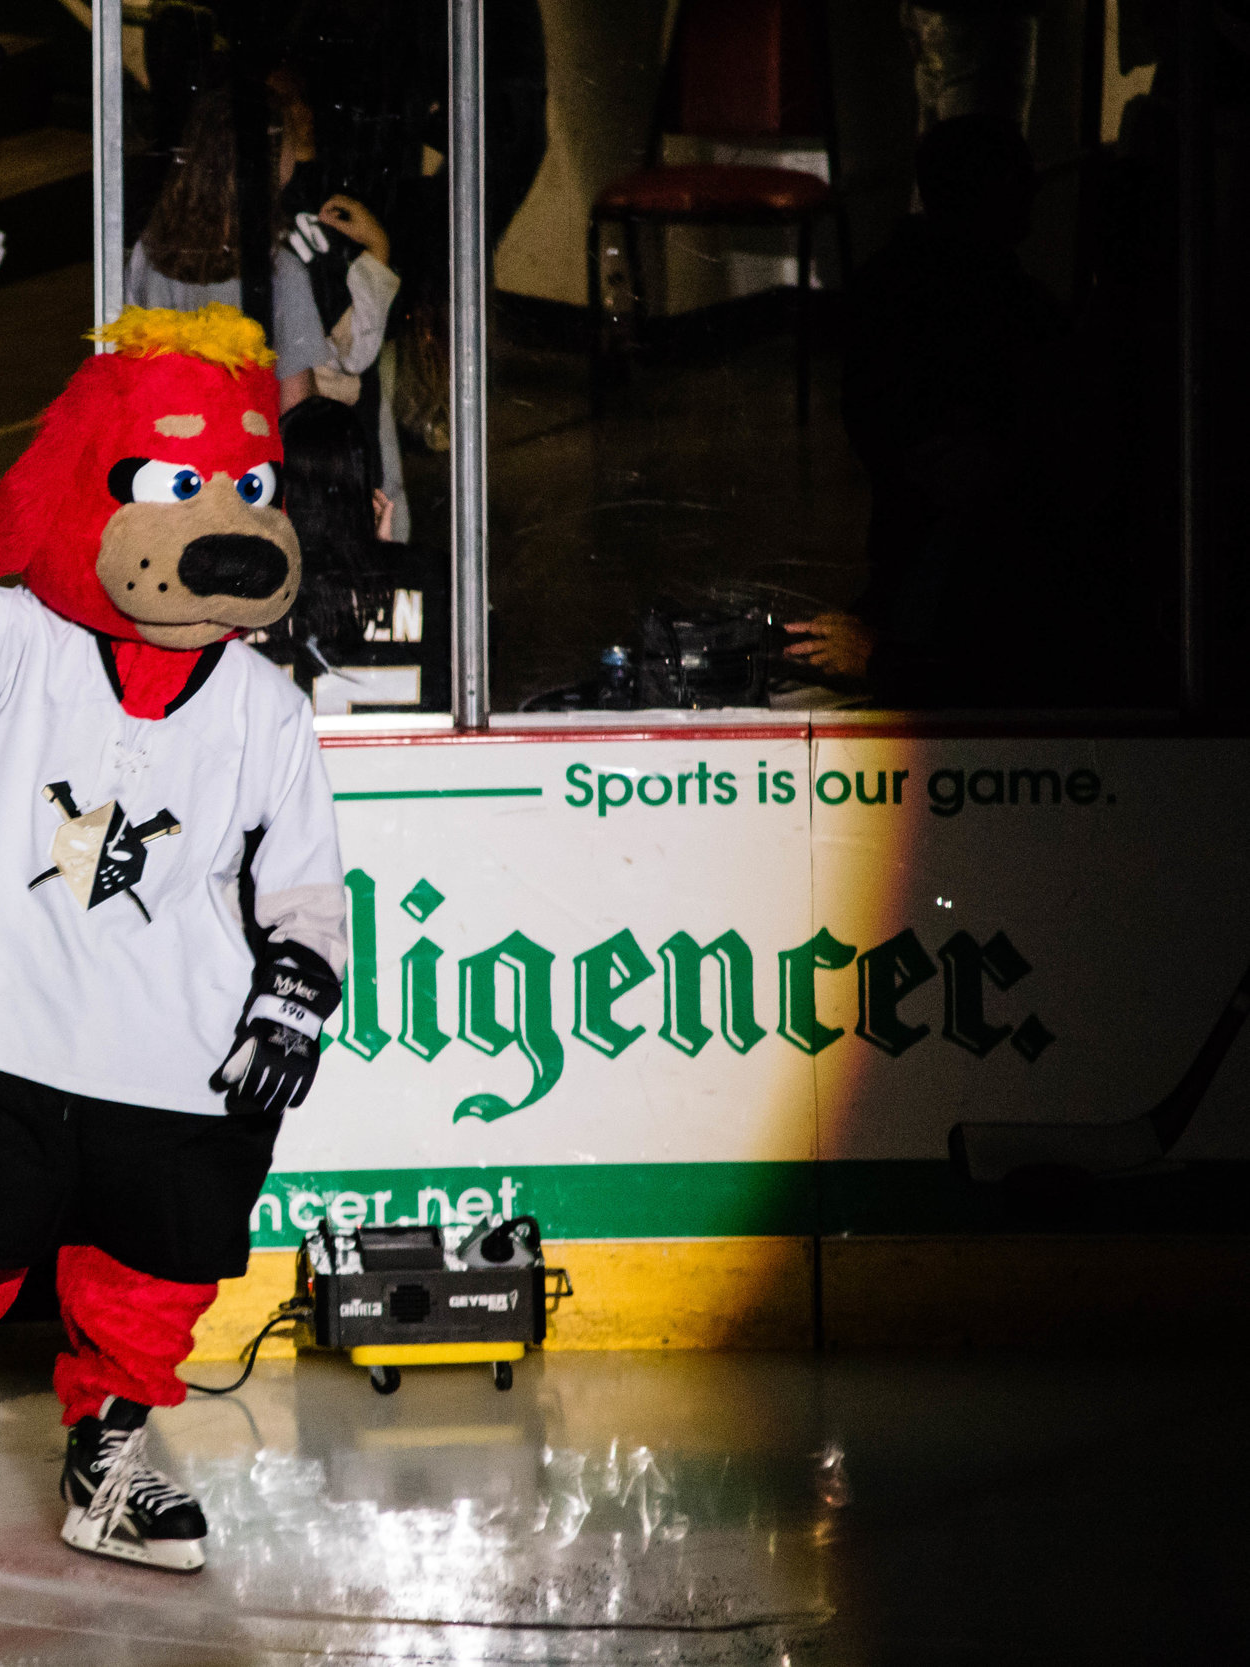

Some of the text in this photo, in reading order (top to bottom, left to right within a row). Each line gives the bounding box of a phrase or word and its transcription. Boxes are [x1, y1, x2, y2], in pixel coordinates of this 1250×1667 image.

[564, 760, 1118, 817] Sports is our game.
[322, 868, 1057, 1125] ligencer.
